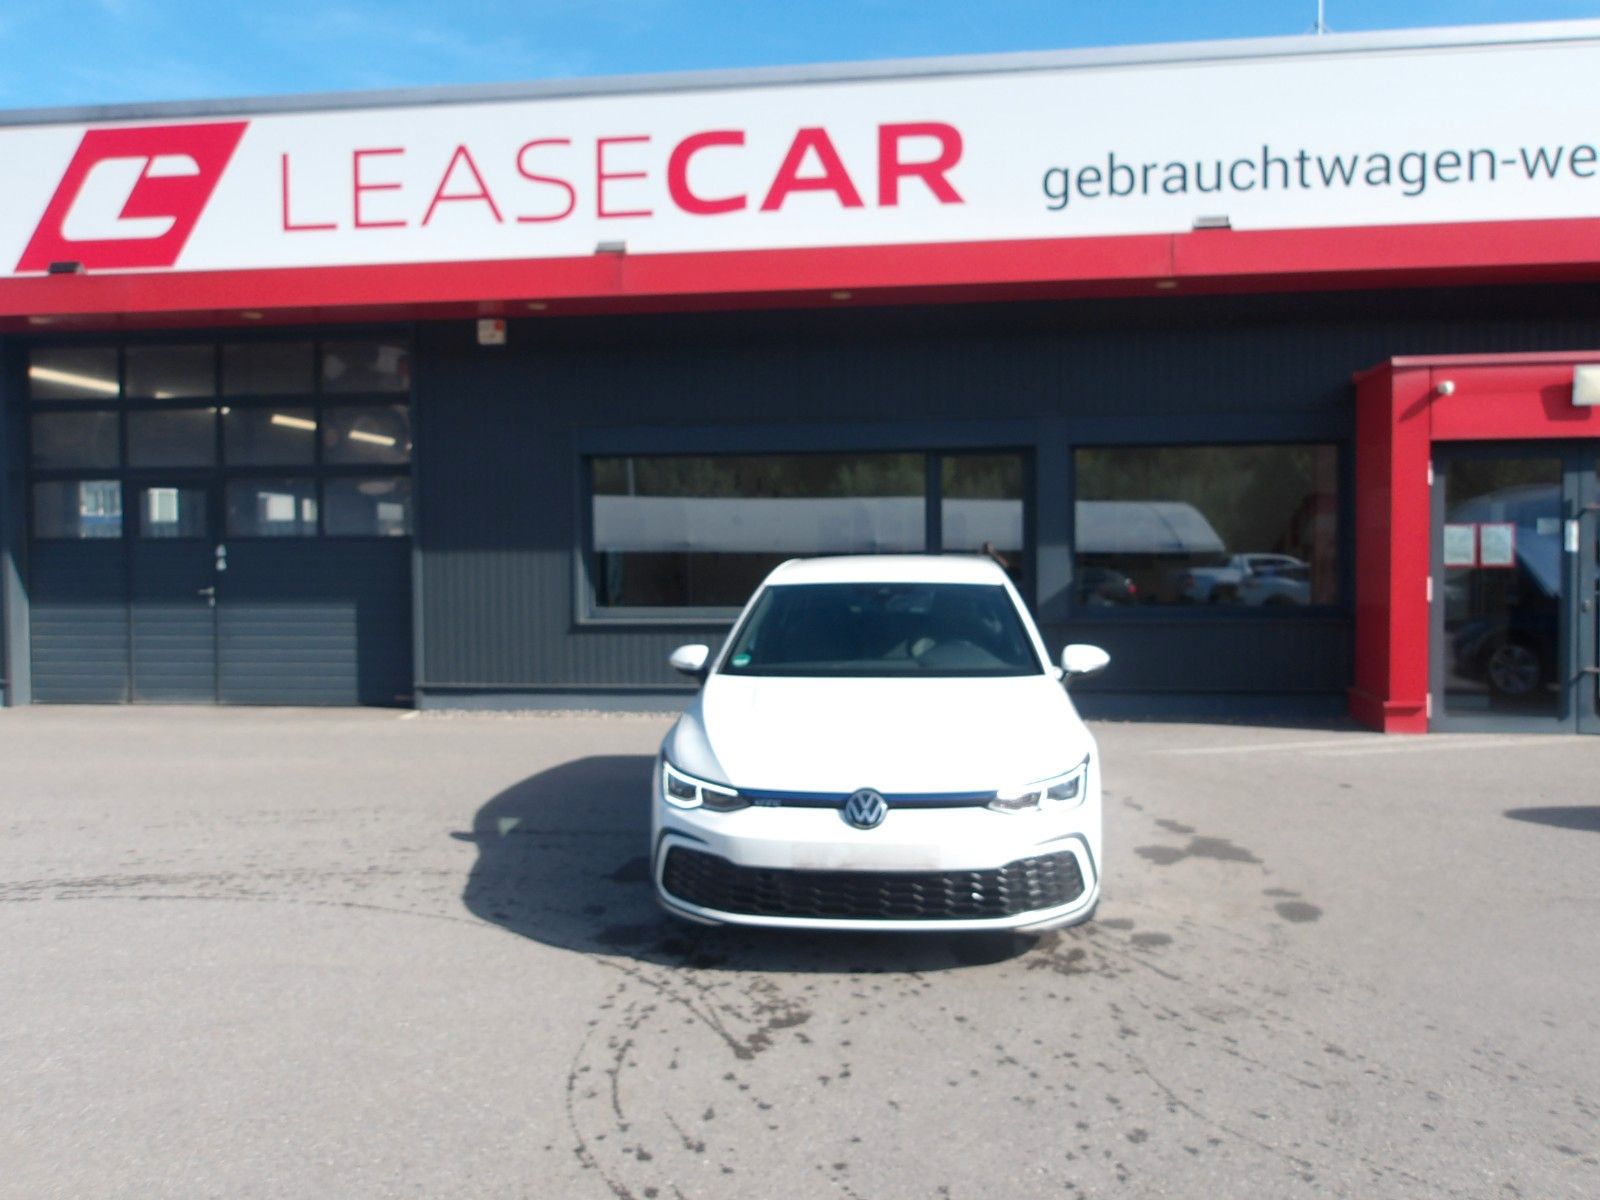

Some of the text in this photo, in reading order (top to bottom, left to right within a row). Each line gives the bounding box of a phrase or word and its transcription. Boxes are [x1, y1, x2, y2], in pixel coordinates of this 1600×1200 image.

[281, 120, 965, 233] LEASECAR
[1042, 144, 1598, 211] gebrauchtwagen-we
[846, 788, 888, 829] VW
